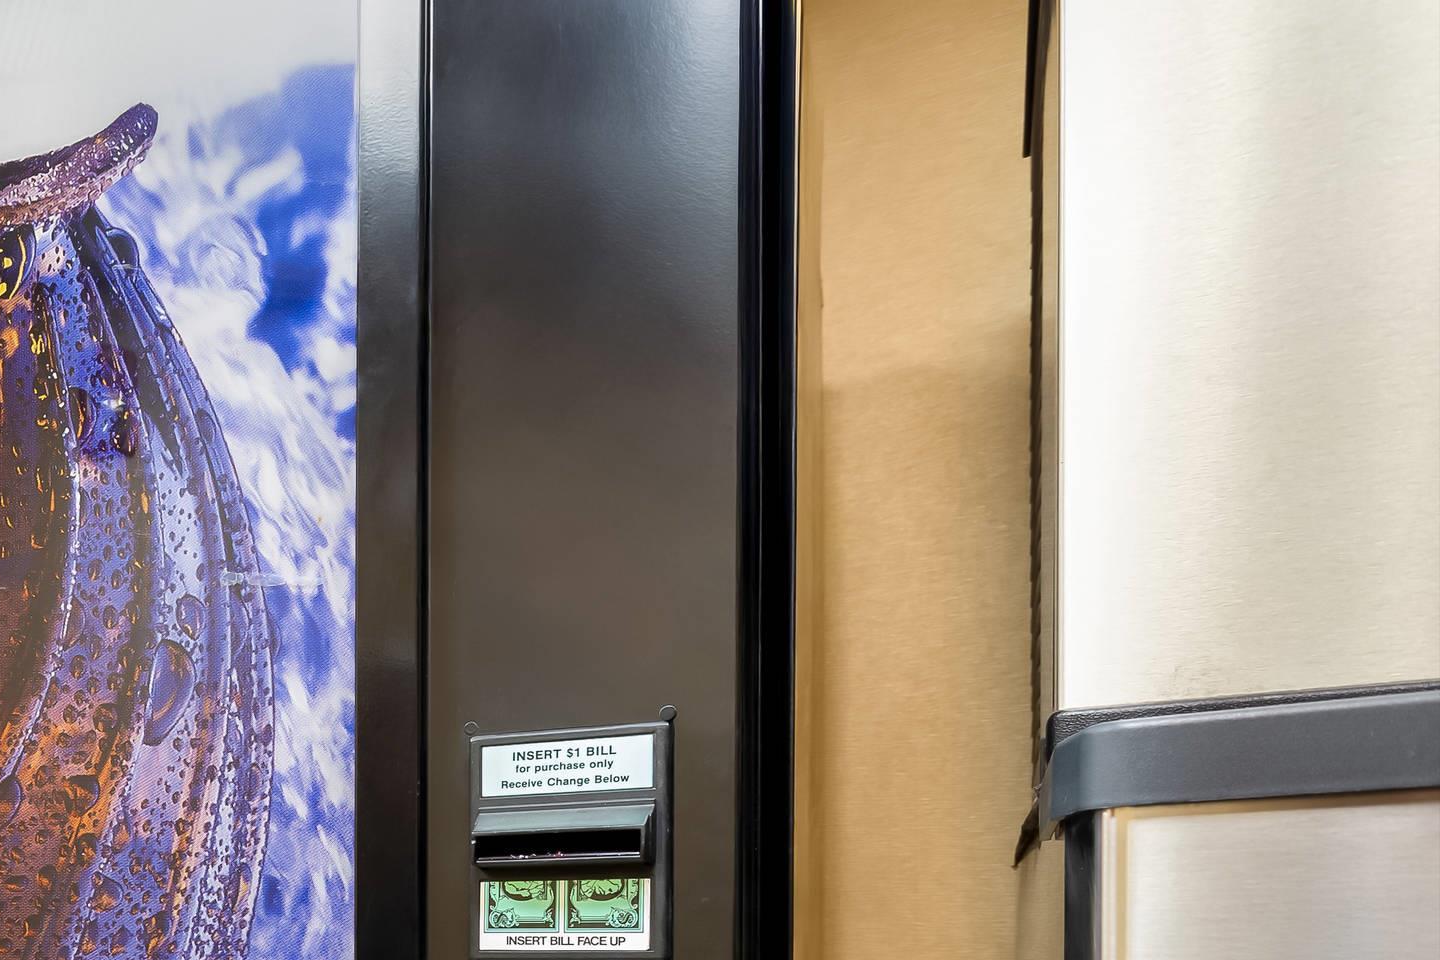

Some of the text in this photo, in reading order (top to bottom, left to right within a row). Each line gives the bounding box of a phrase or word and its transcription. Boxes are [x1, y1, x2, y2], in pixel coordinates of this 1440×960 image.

[513, 745, 617, 761] INSERT $1 BILL
[516, 759, 614, 774] for purchase only
[501, 774, 630, 789] Receive Change Below
[506, 936, 626, 946] INSERT BILL FACE UP
